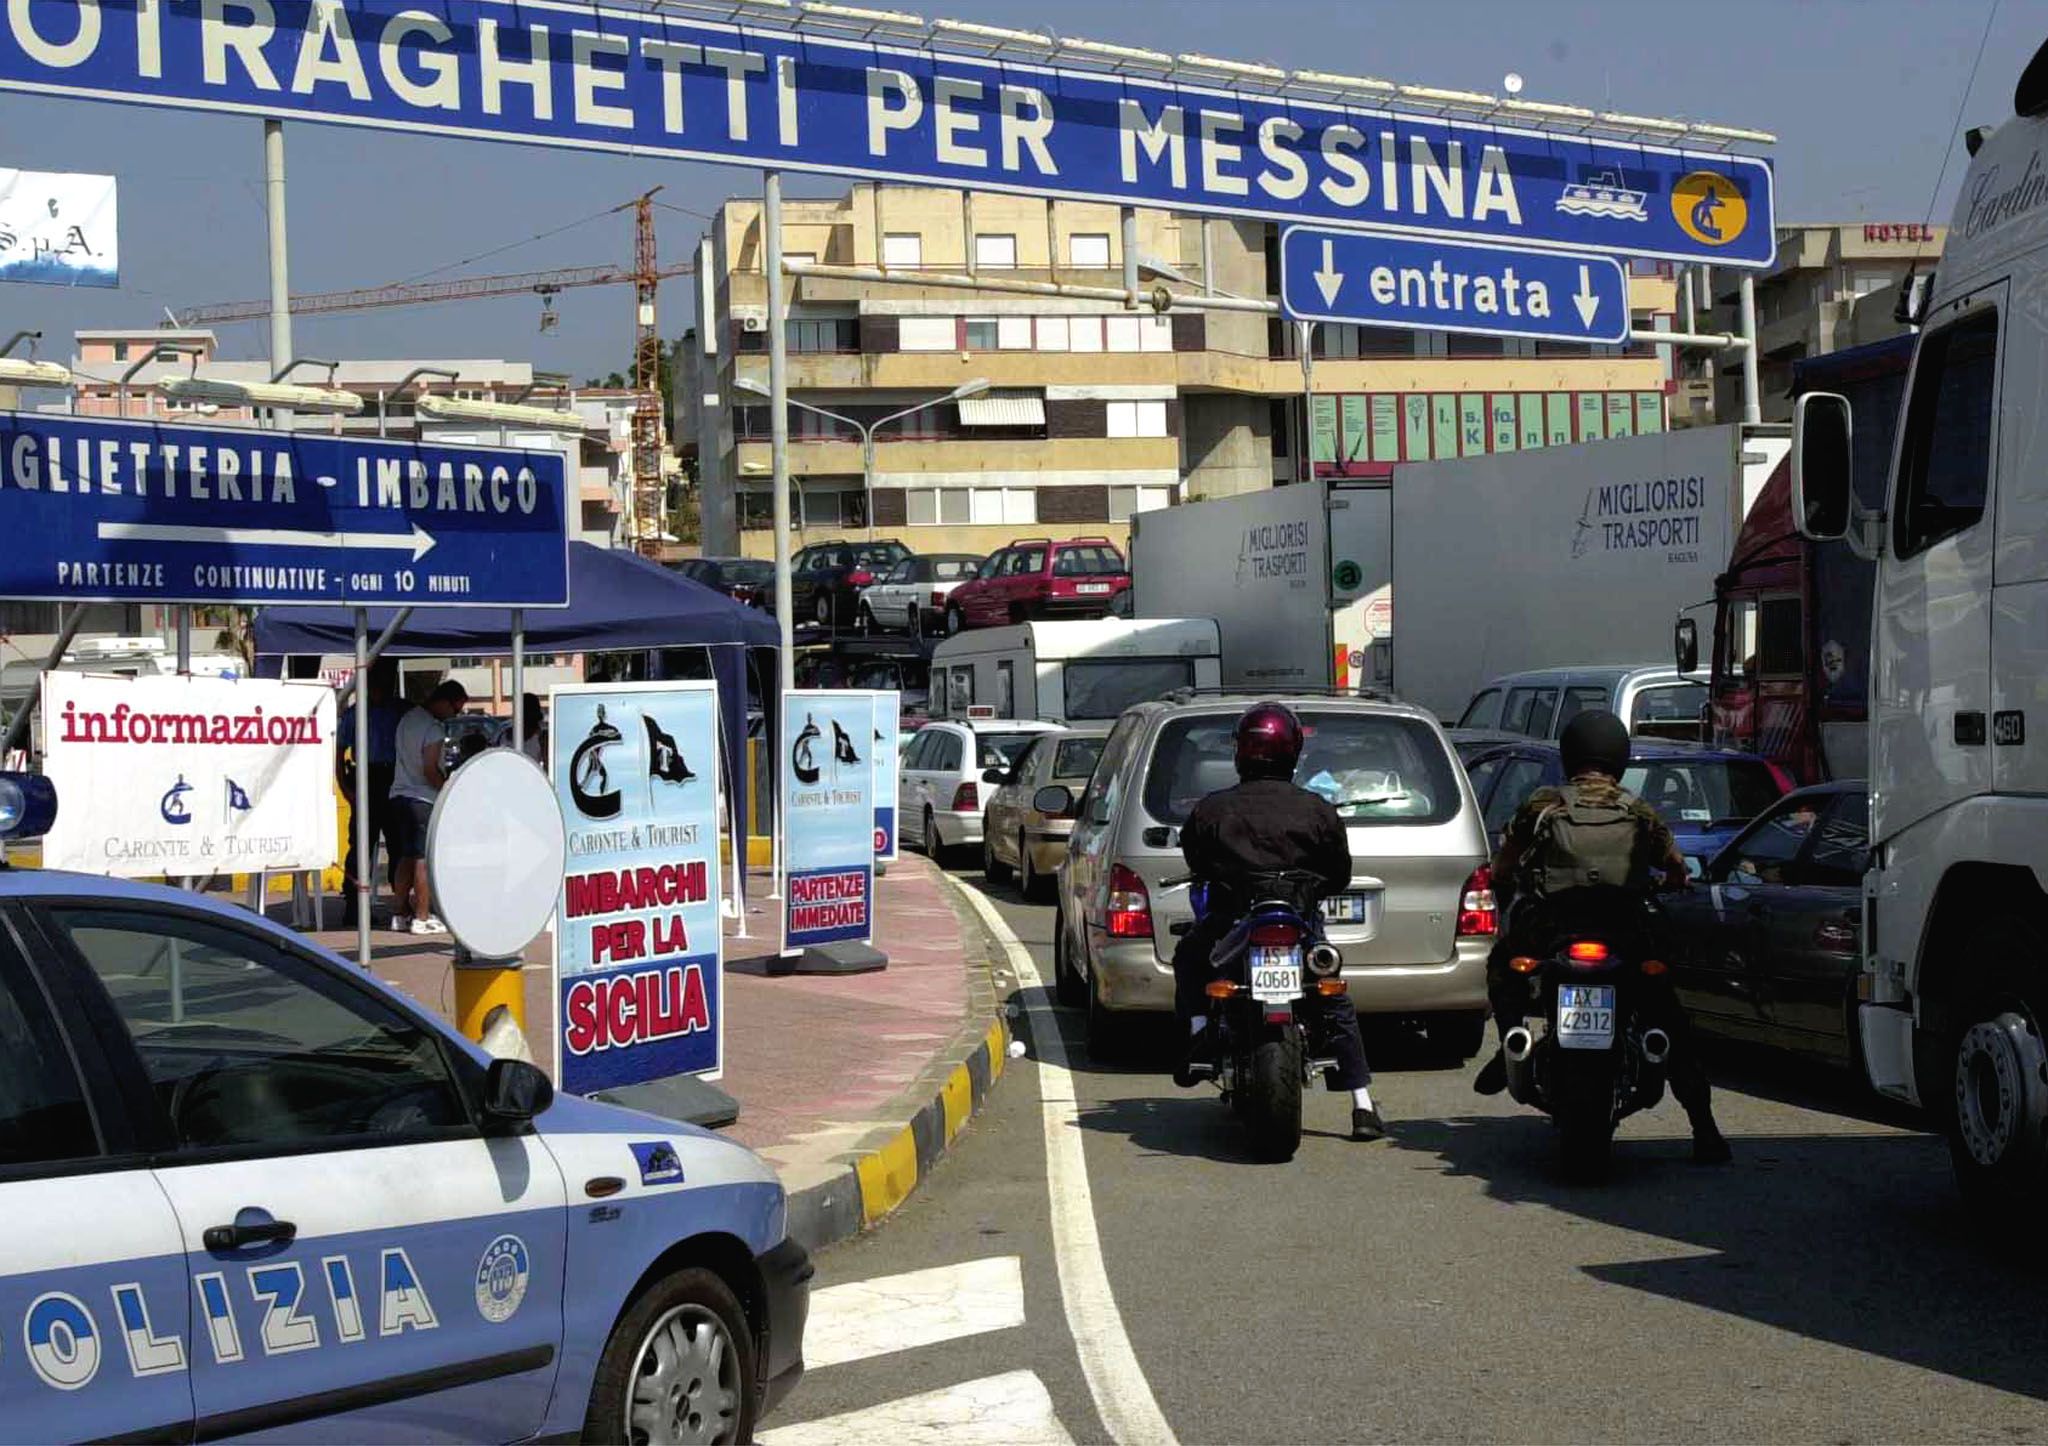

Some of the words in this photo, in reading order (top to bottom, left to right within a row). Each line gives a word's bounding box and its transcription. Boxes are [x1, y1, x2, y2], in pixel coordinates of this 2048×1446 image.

[866, 66, 1059, 176] PER
[1119, 98, 1523, 226] MESSINA
[1966, 150, 2048, 240] Cardin
[1864, 223, 1934, 243] HOTEL
[1370, 260, 1551, 318] entrata
[0, 432, 297, 504] GLIETTERIA
[357, 457, 537, 515] IMBARCO
[1599, 476, 1704, 516] MIGLIORISI
[1249, 521, 1309, 551] MIGLIORISI
[1603, 517, 1699, 549] TRASPORTI
[58, 562, 164, 587] PARTENZE
[194, 565, 326, 591] CONTINUATIVE
[351, 573, 383, 592] OGNI
[394, 570, 415, 592] 10
[429, 575, 470, 592] MINUTI
[1252, 552, 1307, 580] TRASPORTI
[60, 700, 323, 746] informazioni
[104, 836, 190, 859] CARONTE
[200, 835, 215, 856] &
[224, 834, 293, 855] TOURIST
[569, 830, 630, 856] CARONTE
[631, 825, 641, 848] &
[645, 823, 699, 847] TOURIST
[565, 861, 708, 919] IMBARCHI
[791, 873, 865, 904] PARTENZE
[791, 902, 866, 932] IMMEDIATE
[592, 920, 646, 965] PER
[653, 915, 688, 955] LA
[1263, 947, 1282, 966] AS
[1254, 970, 1299, 990] 40681
[567, 967, 708, 1053] SICILIA
[1575, 988, 1593, 1006] AX
[1563, 1011, 1611, 1031] 42912
[23, 1247, 439, 1391] OLIZIA
